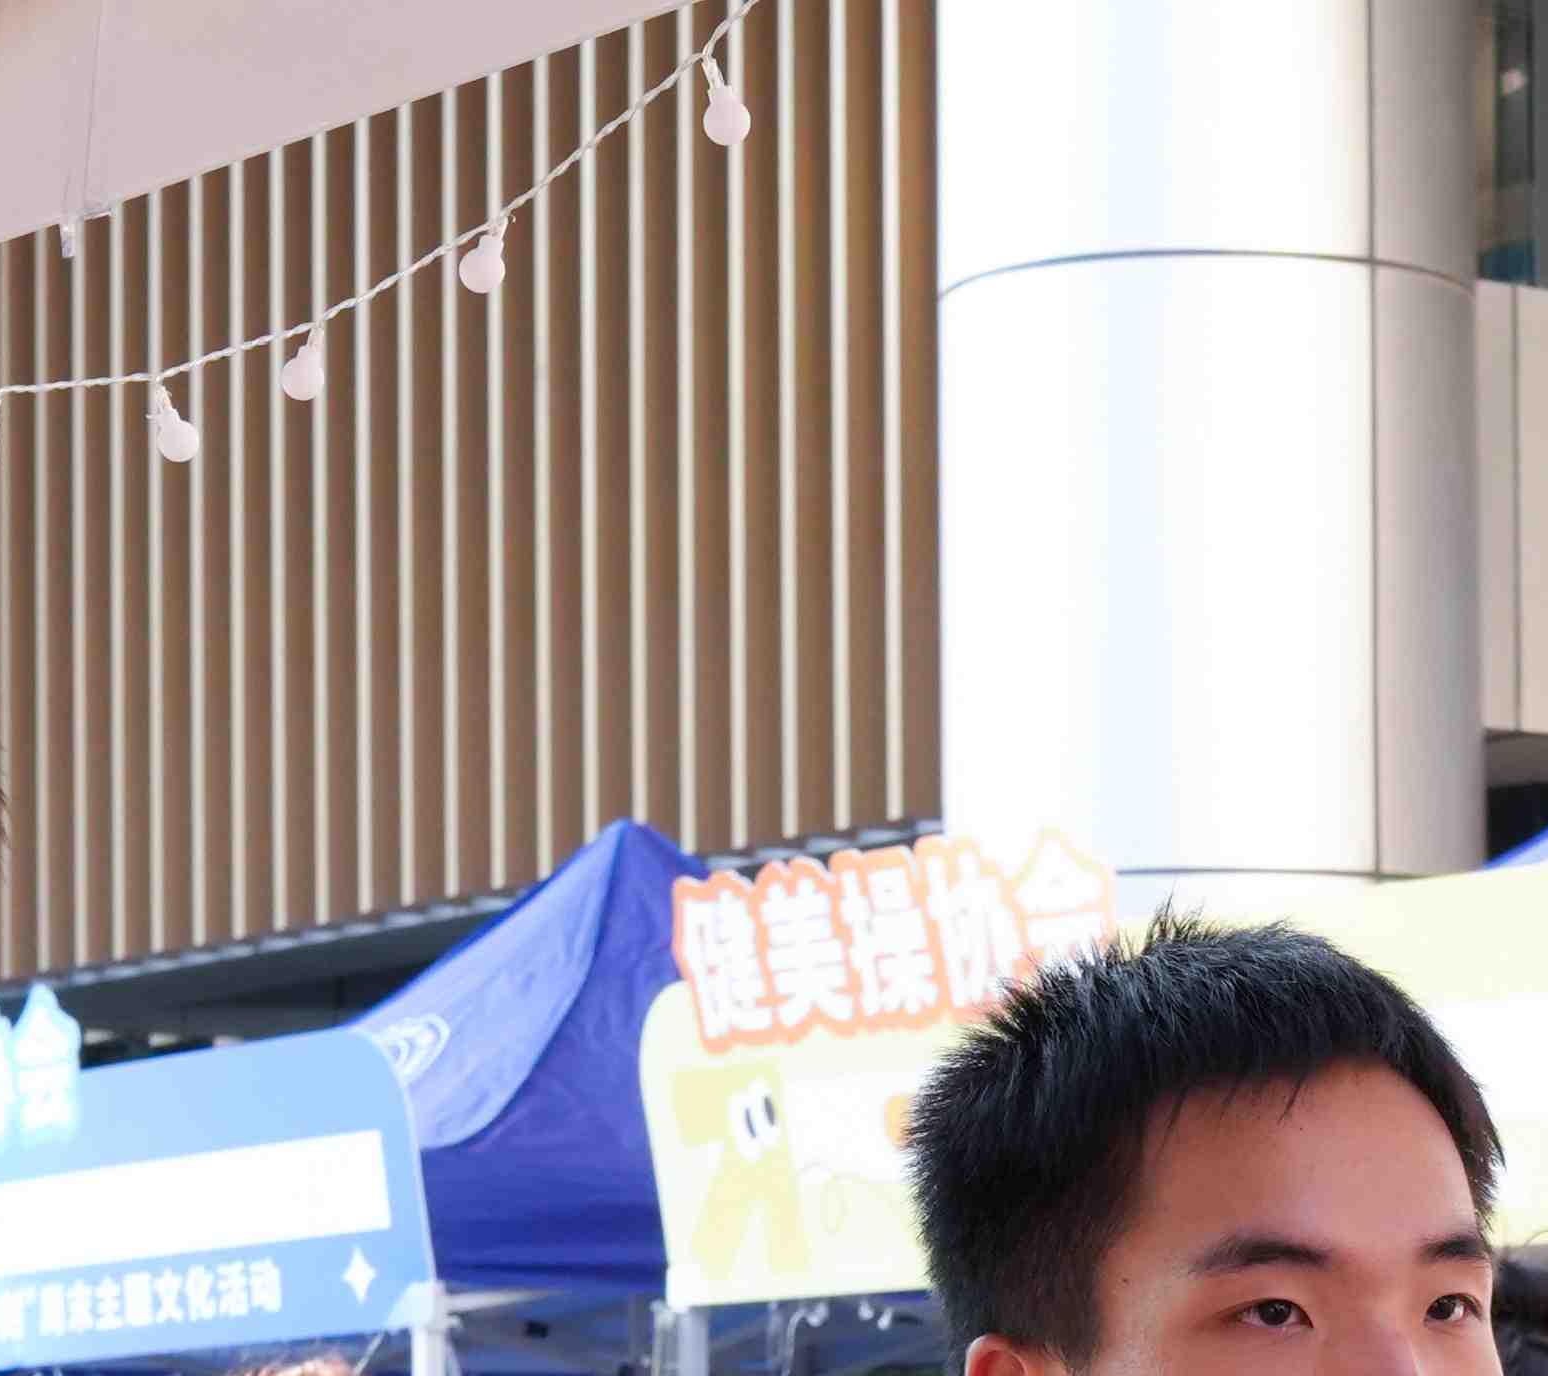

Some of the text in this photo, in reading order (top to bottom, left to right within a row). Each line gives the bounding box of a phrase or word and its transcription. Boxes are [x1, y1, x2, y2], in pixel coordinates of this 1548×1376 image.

[680, 838, 1107, 1040] 健美操协会
